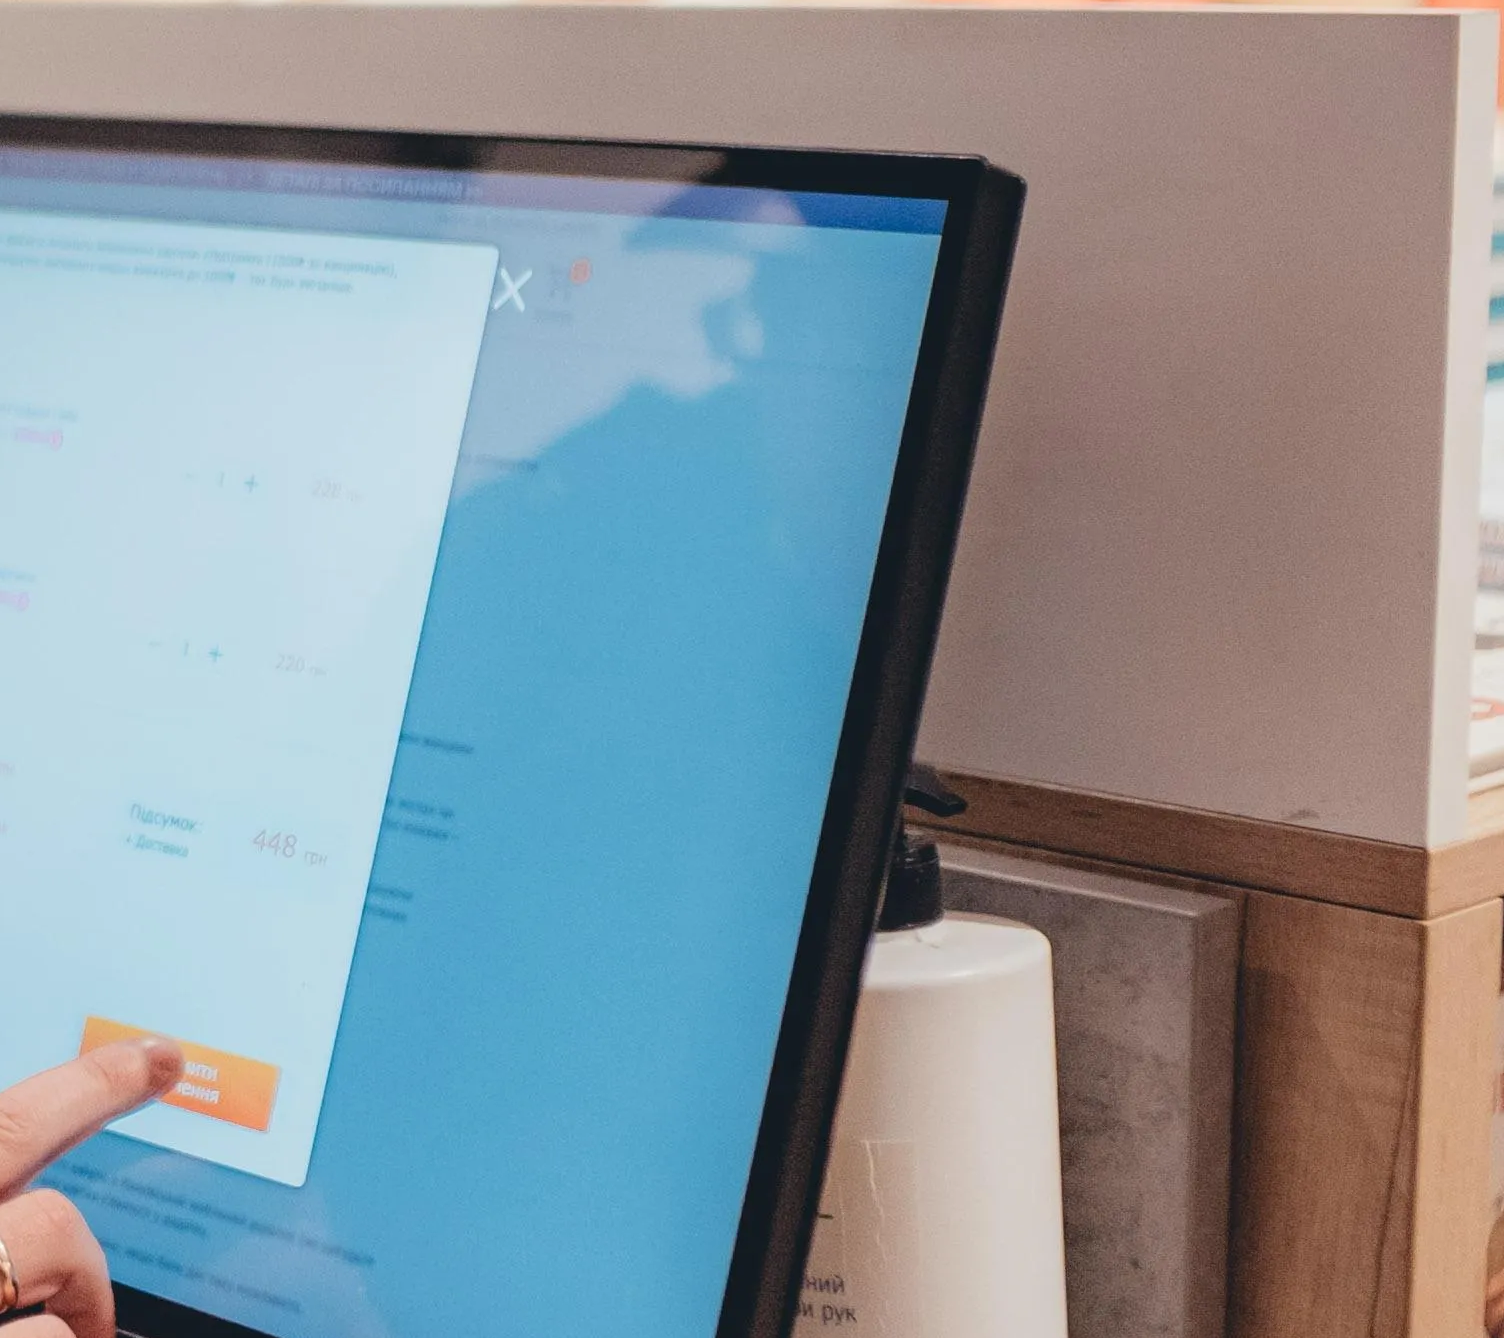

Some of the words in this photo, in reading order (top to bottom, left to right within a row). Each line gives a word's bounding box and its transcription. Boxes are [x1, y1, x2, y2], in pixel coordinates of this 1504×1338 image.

[130, 802, 203, 833] Підсумок:
[252, 828, 298, 858] 448
[304, 850, 328, 866] грн
[803, 1273, 845, 1294] ний
[822, 1304, 857, 1326] рук
